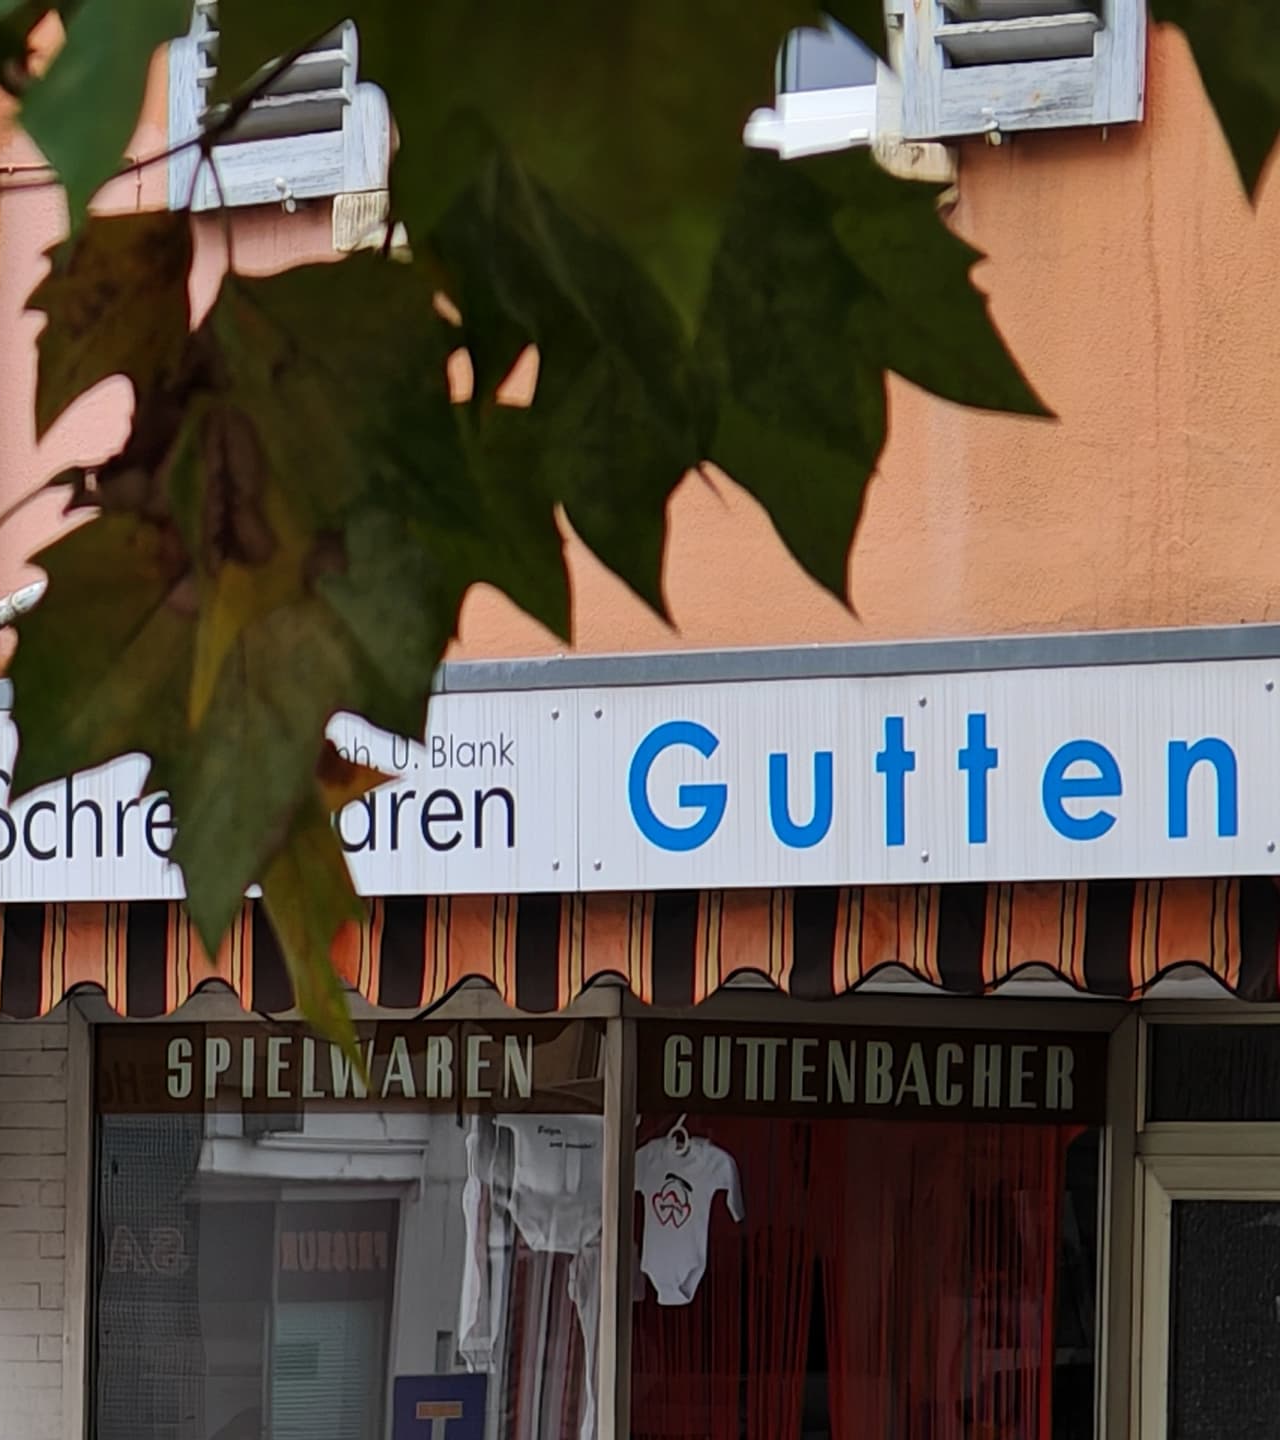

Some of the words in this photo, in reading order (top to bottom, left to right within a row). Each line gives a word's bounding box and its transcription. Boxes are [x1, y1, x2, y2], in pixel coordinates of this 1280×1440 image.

[392, 732, 419, 770] U.
[432, 732, 515, 769] Blank
[629, 712, 1238, 852] Gutten
[167, 1034, 534, 1100] SPIELWAREN
[663, 1033, 1075, 1110] GUTTENBACHER
